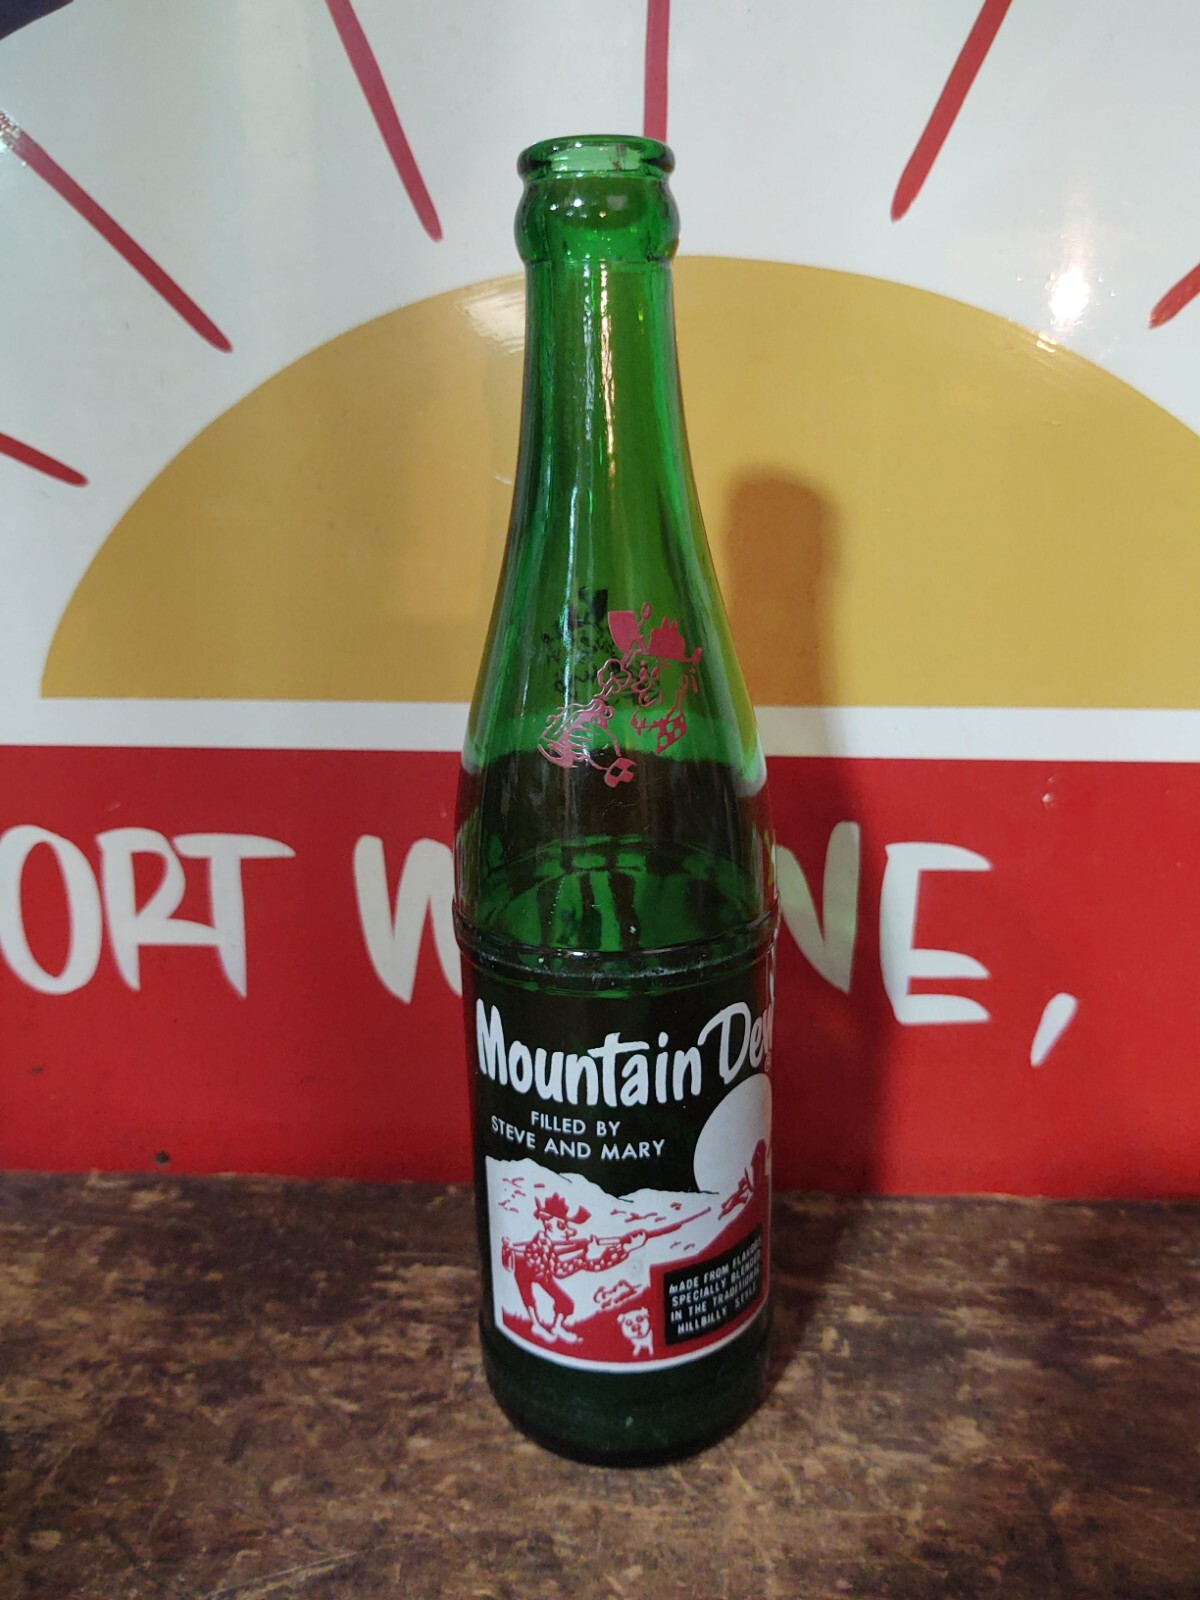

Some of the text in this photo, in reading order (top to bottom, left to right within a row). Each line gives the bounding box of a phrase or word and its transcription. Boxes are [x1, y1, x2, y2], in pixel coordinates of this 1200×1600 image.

[476, 984, 774, 1107] Mountain Dew
[491, 1115, 666, 1161] STEVE AND MARY
[530, 1110, 621, 1137] FILLED BY
[669, 1276, 699, 1294] MADE
[703, 1264, 729, 1283] FROM
[671, 1278, 726, 1307] SPECIALLY
[670, 1309, 682, 1322] IN
[688, 1301, 707, 1316] THE
[677, 1305, 727, 1335] HILLBILLY
